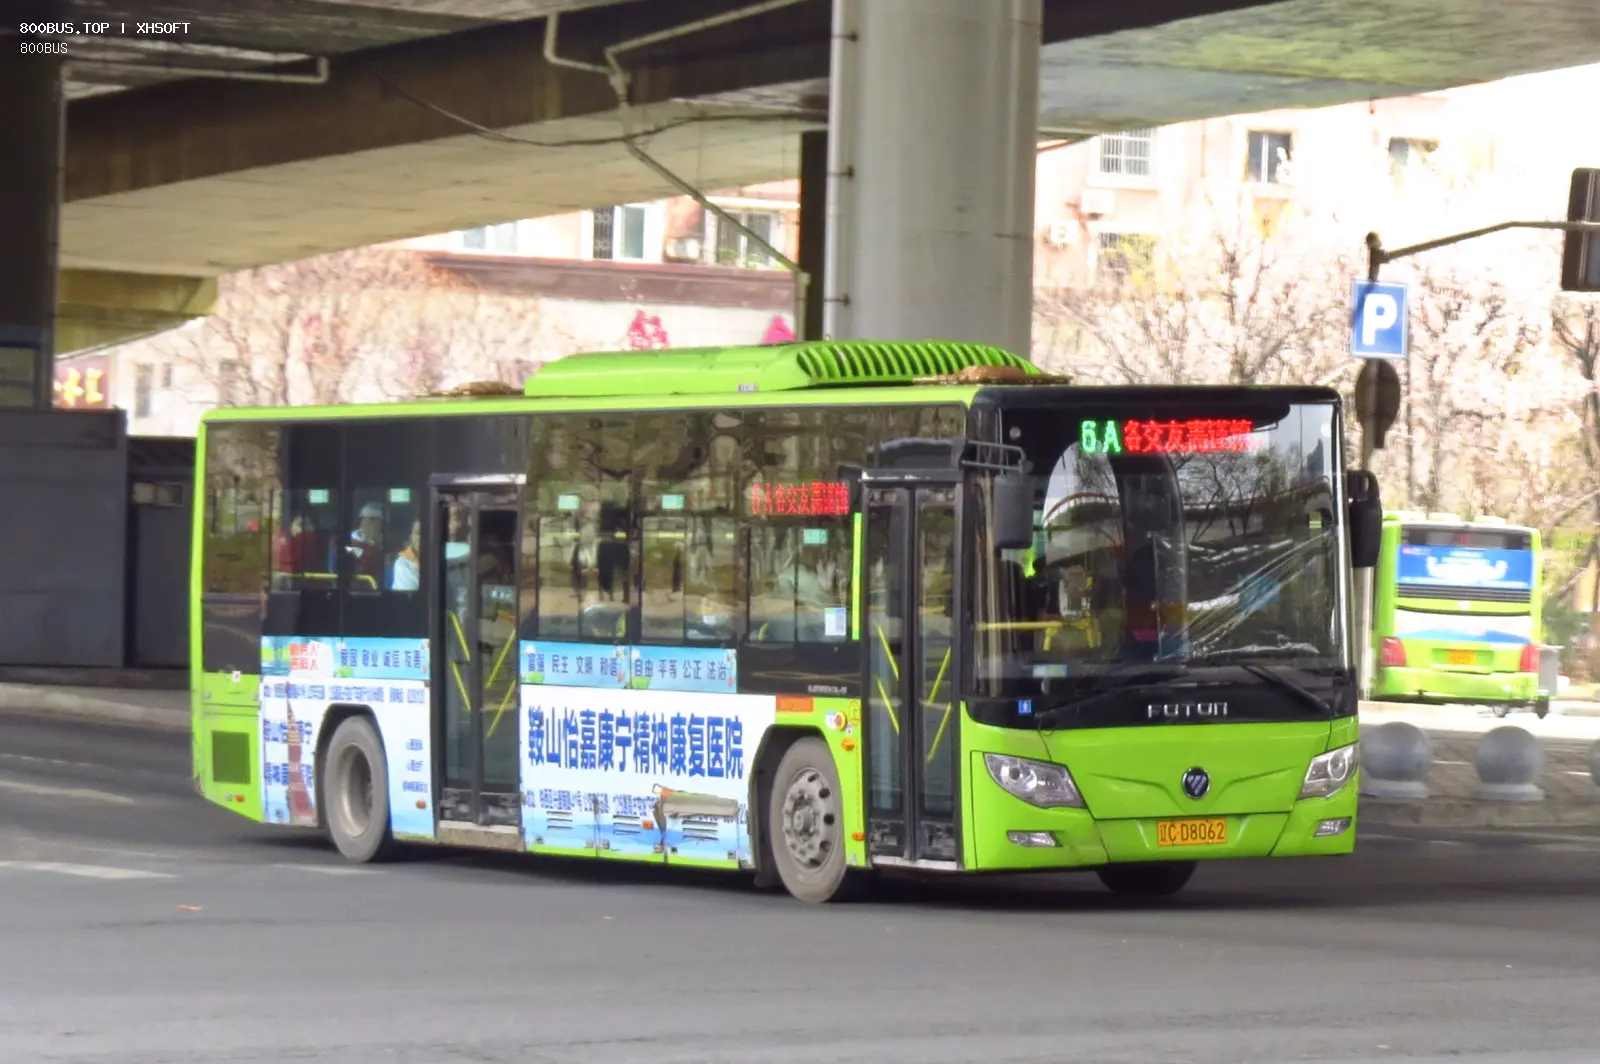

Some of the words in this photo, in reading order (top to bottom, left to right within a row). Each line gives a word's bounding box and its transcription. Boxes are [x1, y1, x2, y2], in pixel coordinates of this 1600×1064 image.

[1362, 293, 1397, 346] P
[1080, 419, 1122, 453] 6A
[551, 654, 569, 673] 民主
[634, 658, 653, 677] 自由
[658, 659, 677, 679] 平等
[682, 660, 702, 679] 公正
[528, 706, 743, 779] 鞍山怡嘉康宁精神康复医院
